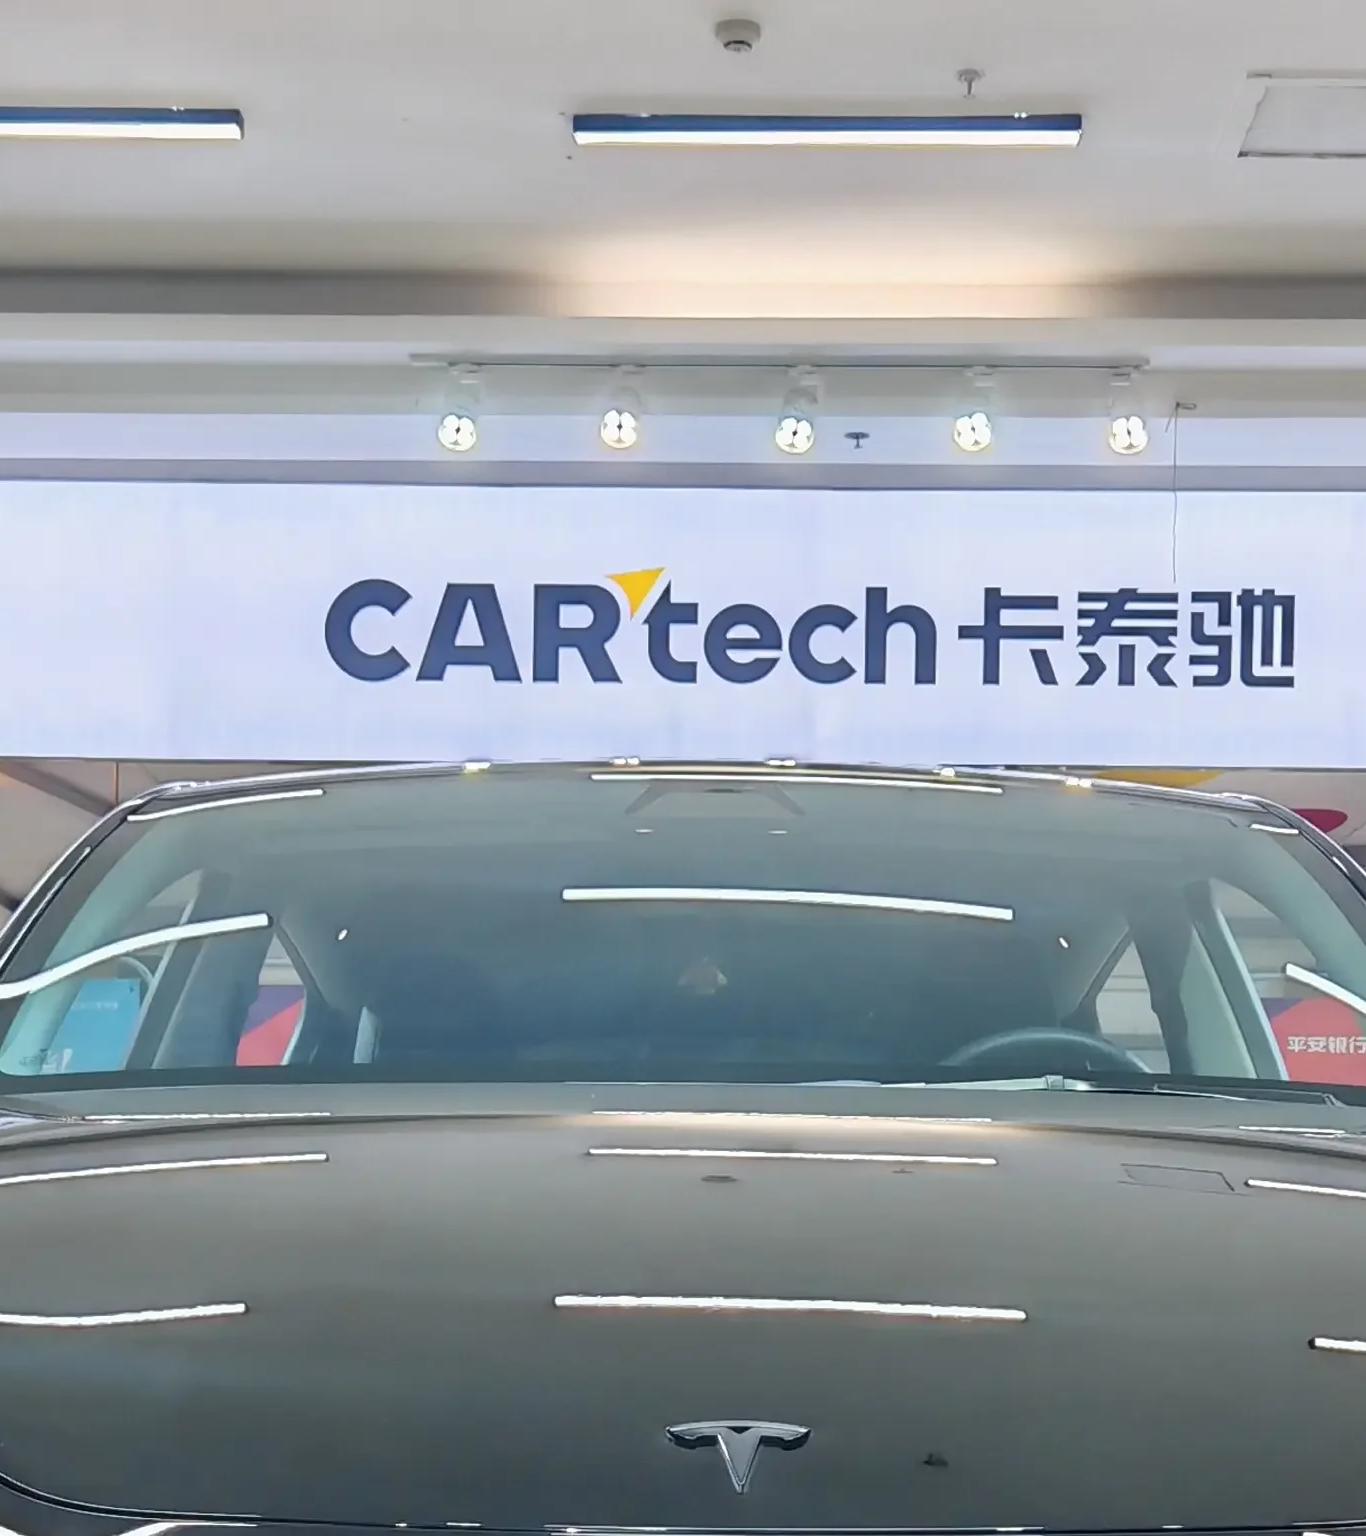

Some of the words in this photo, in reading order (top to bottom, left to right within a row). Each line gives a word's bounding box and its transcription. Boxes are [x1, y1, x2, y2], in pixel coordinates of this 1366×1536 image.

[325, 577, 937, 684] CARtech
[958, 586, 1296, 688] 卡泰驰
